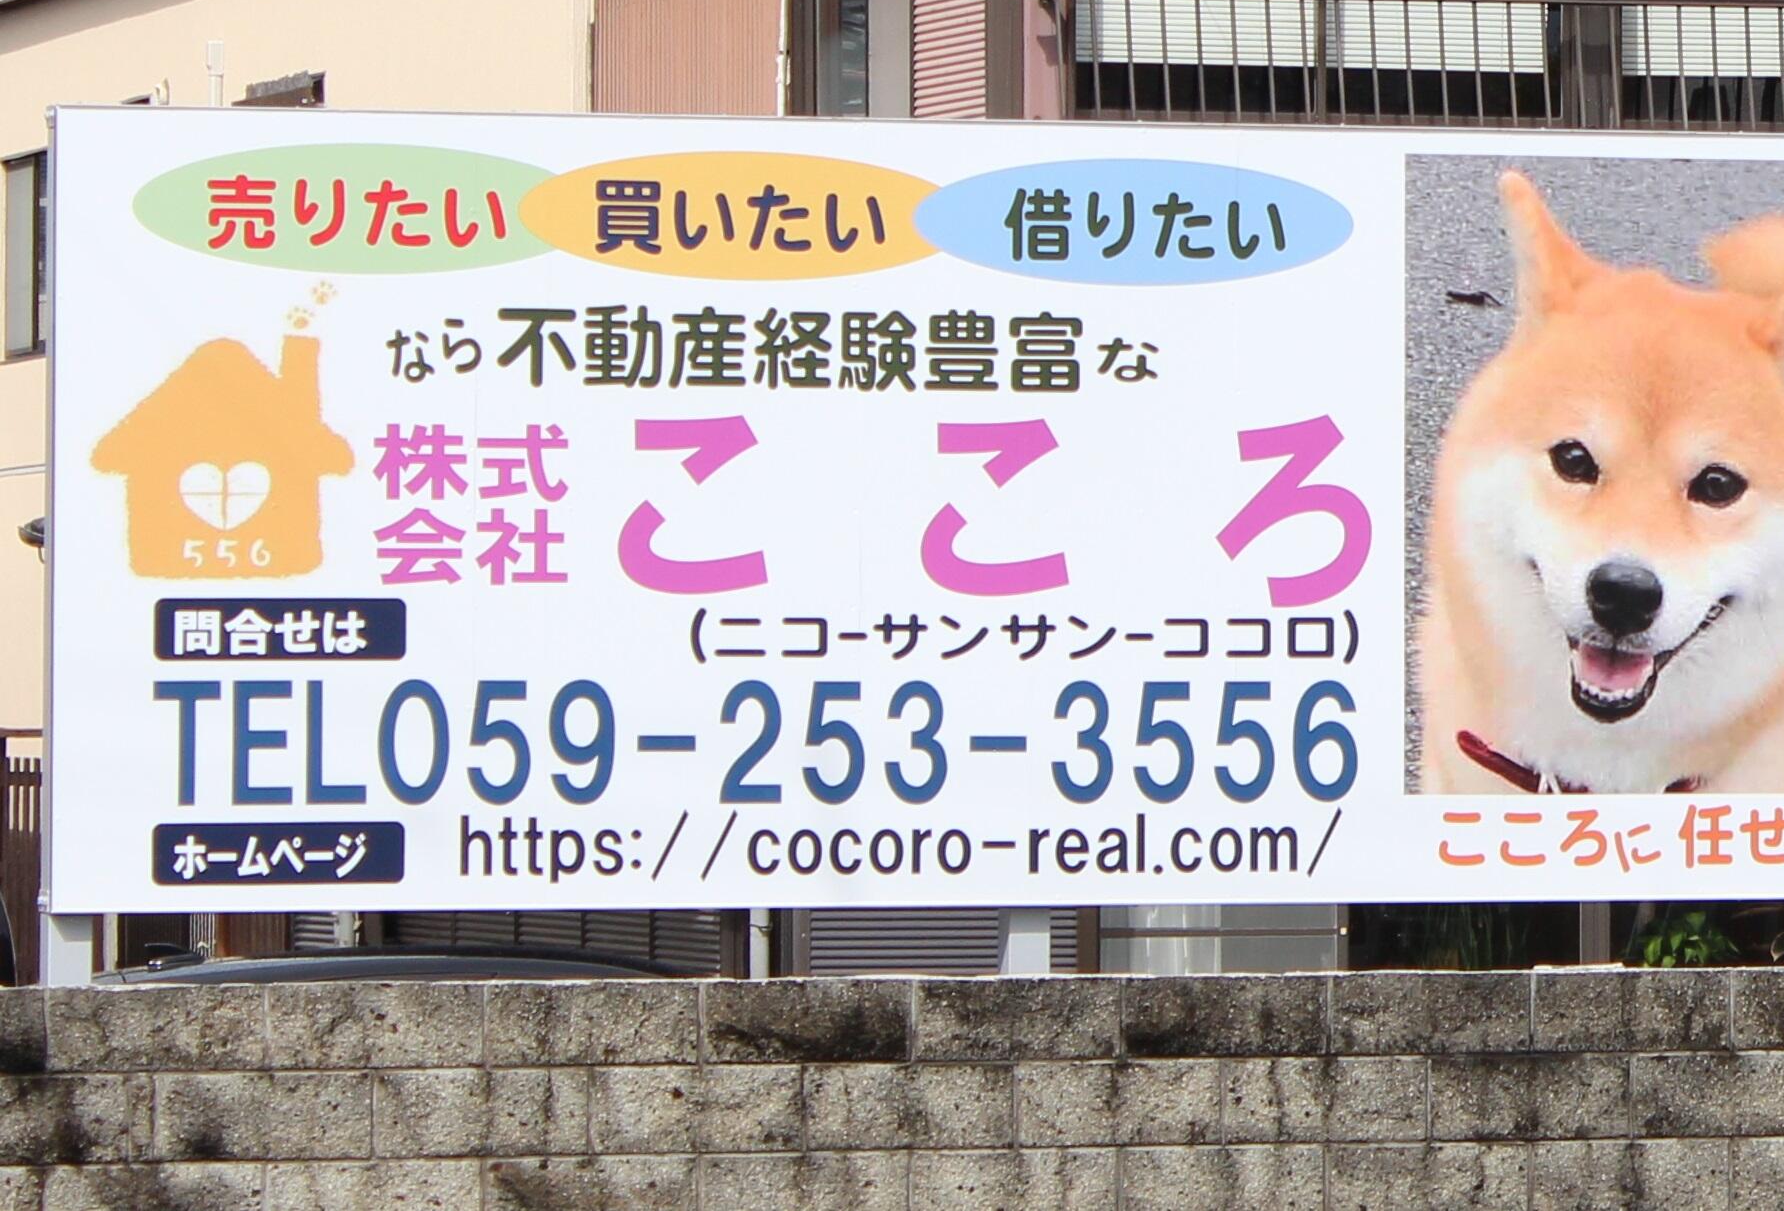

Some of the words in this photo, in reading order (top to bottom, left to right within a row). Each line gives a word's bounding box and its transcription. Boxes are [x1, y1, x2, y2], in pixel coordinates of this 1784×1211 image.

[206, 175, 508, 251] 売りたい
[595, 180, 886, 255] 買いたい
[1004, 188, 1286, 261] 借りたい
[387, 305, 1159, 393] なら不動産経験豊富な
[373, 423, 569, 502] 株式
[373, 508, 569, 586] 会社
[617, 413, 1372, 609] こころ
[183, 538, 272, 568] 556
[172, 609, 367, 656] 問合せは
[172, 834, 367, 876] ホームページ
[458, 809, 1344, 884] https://cocoro-real.com/
